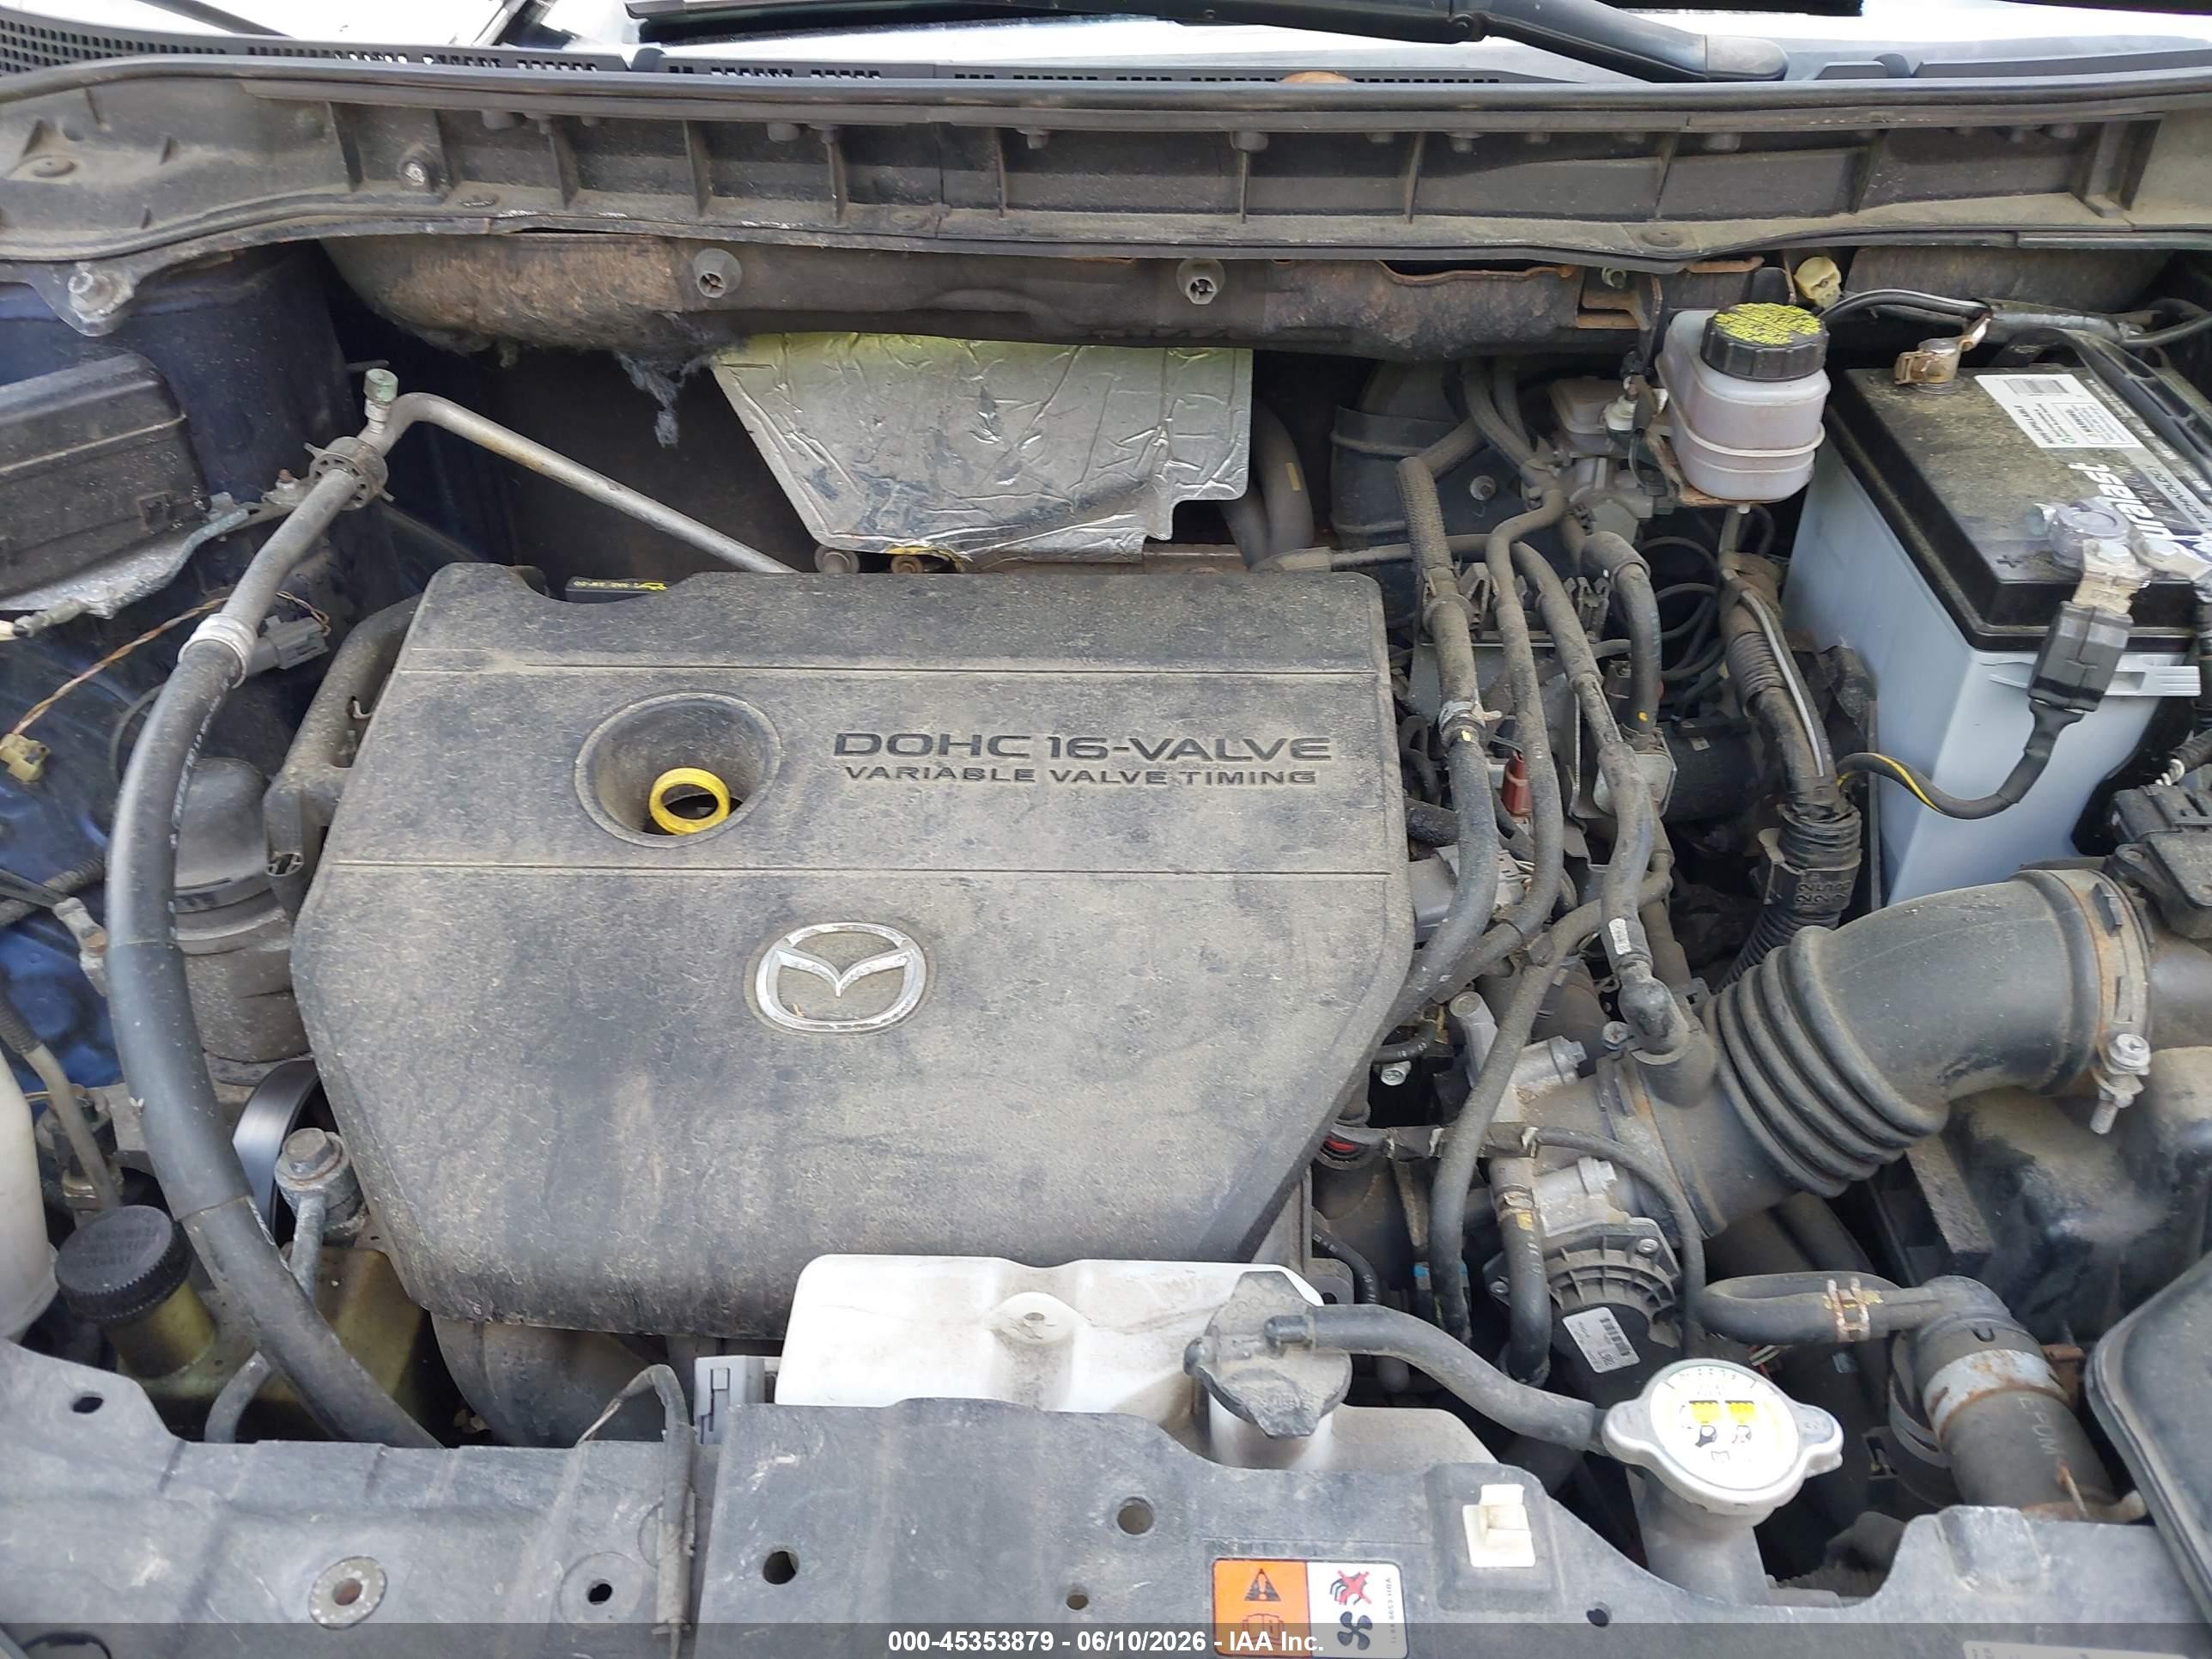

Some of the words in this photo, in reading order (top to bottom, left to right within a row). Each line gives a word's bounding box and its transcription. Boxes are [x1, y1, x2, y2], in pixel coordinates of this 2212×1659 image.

[833, 732, 1031, 757] DOHC
[1047, 736, 1331, 762] 16-VALVE
[844, 765, 1036, 782] VARIABLE
[1049, 769, 1168, 785] VALVE
[1180, 770, 1316, 786] TIMING
